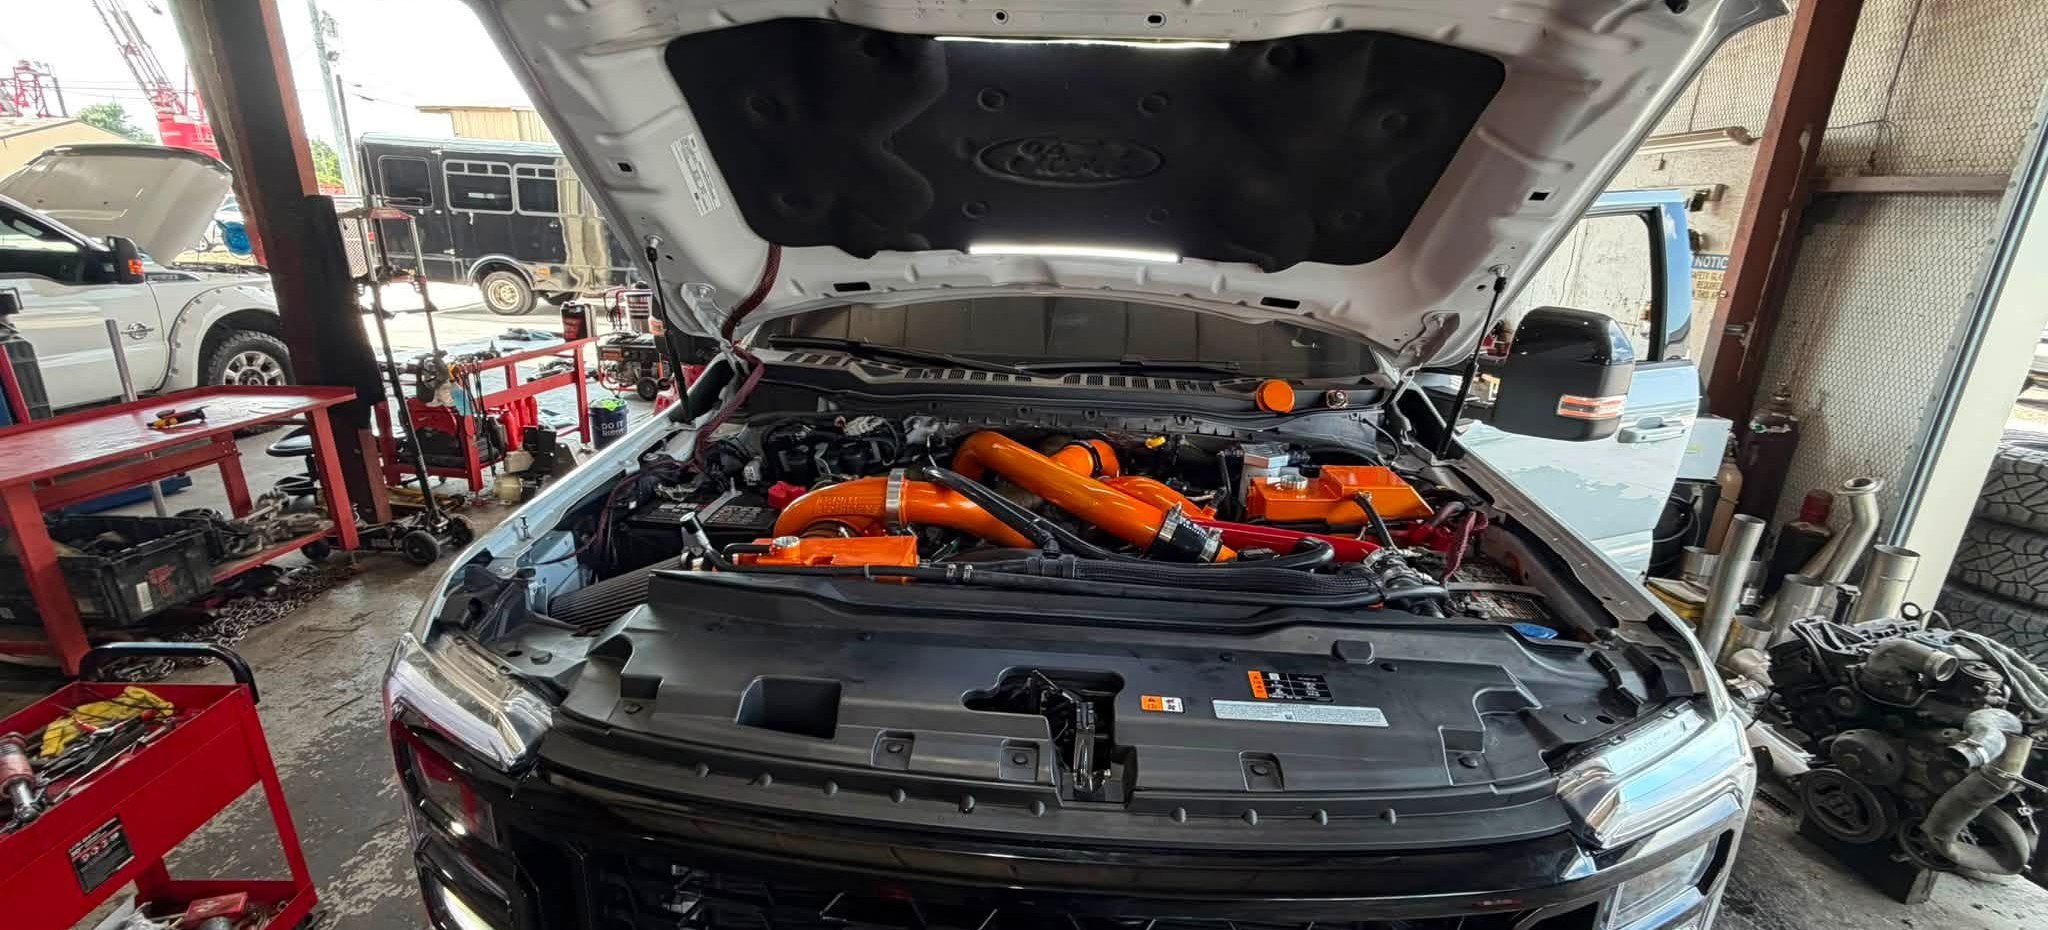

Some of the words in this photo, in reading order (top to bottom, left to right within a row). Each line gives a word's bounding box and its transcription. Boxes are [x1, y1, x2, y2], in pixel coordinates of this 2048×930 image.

[1006, 137, 1134, 179] Ford
[1695, 256, 1728, 269] NOTIC
[601, 422, 615, 430] DO
